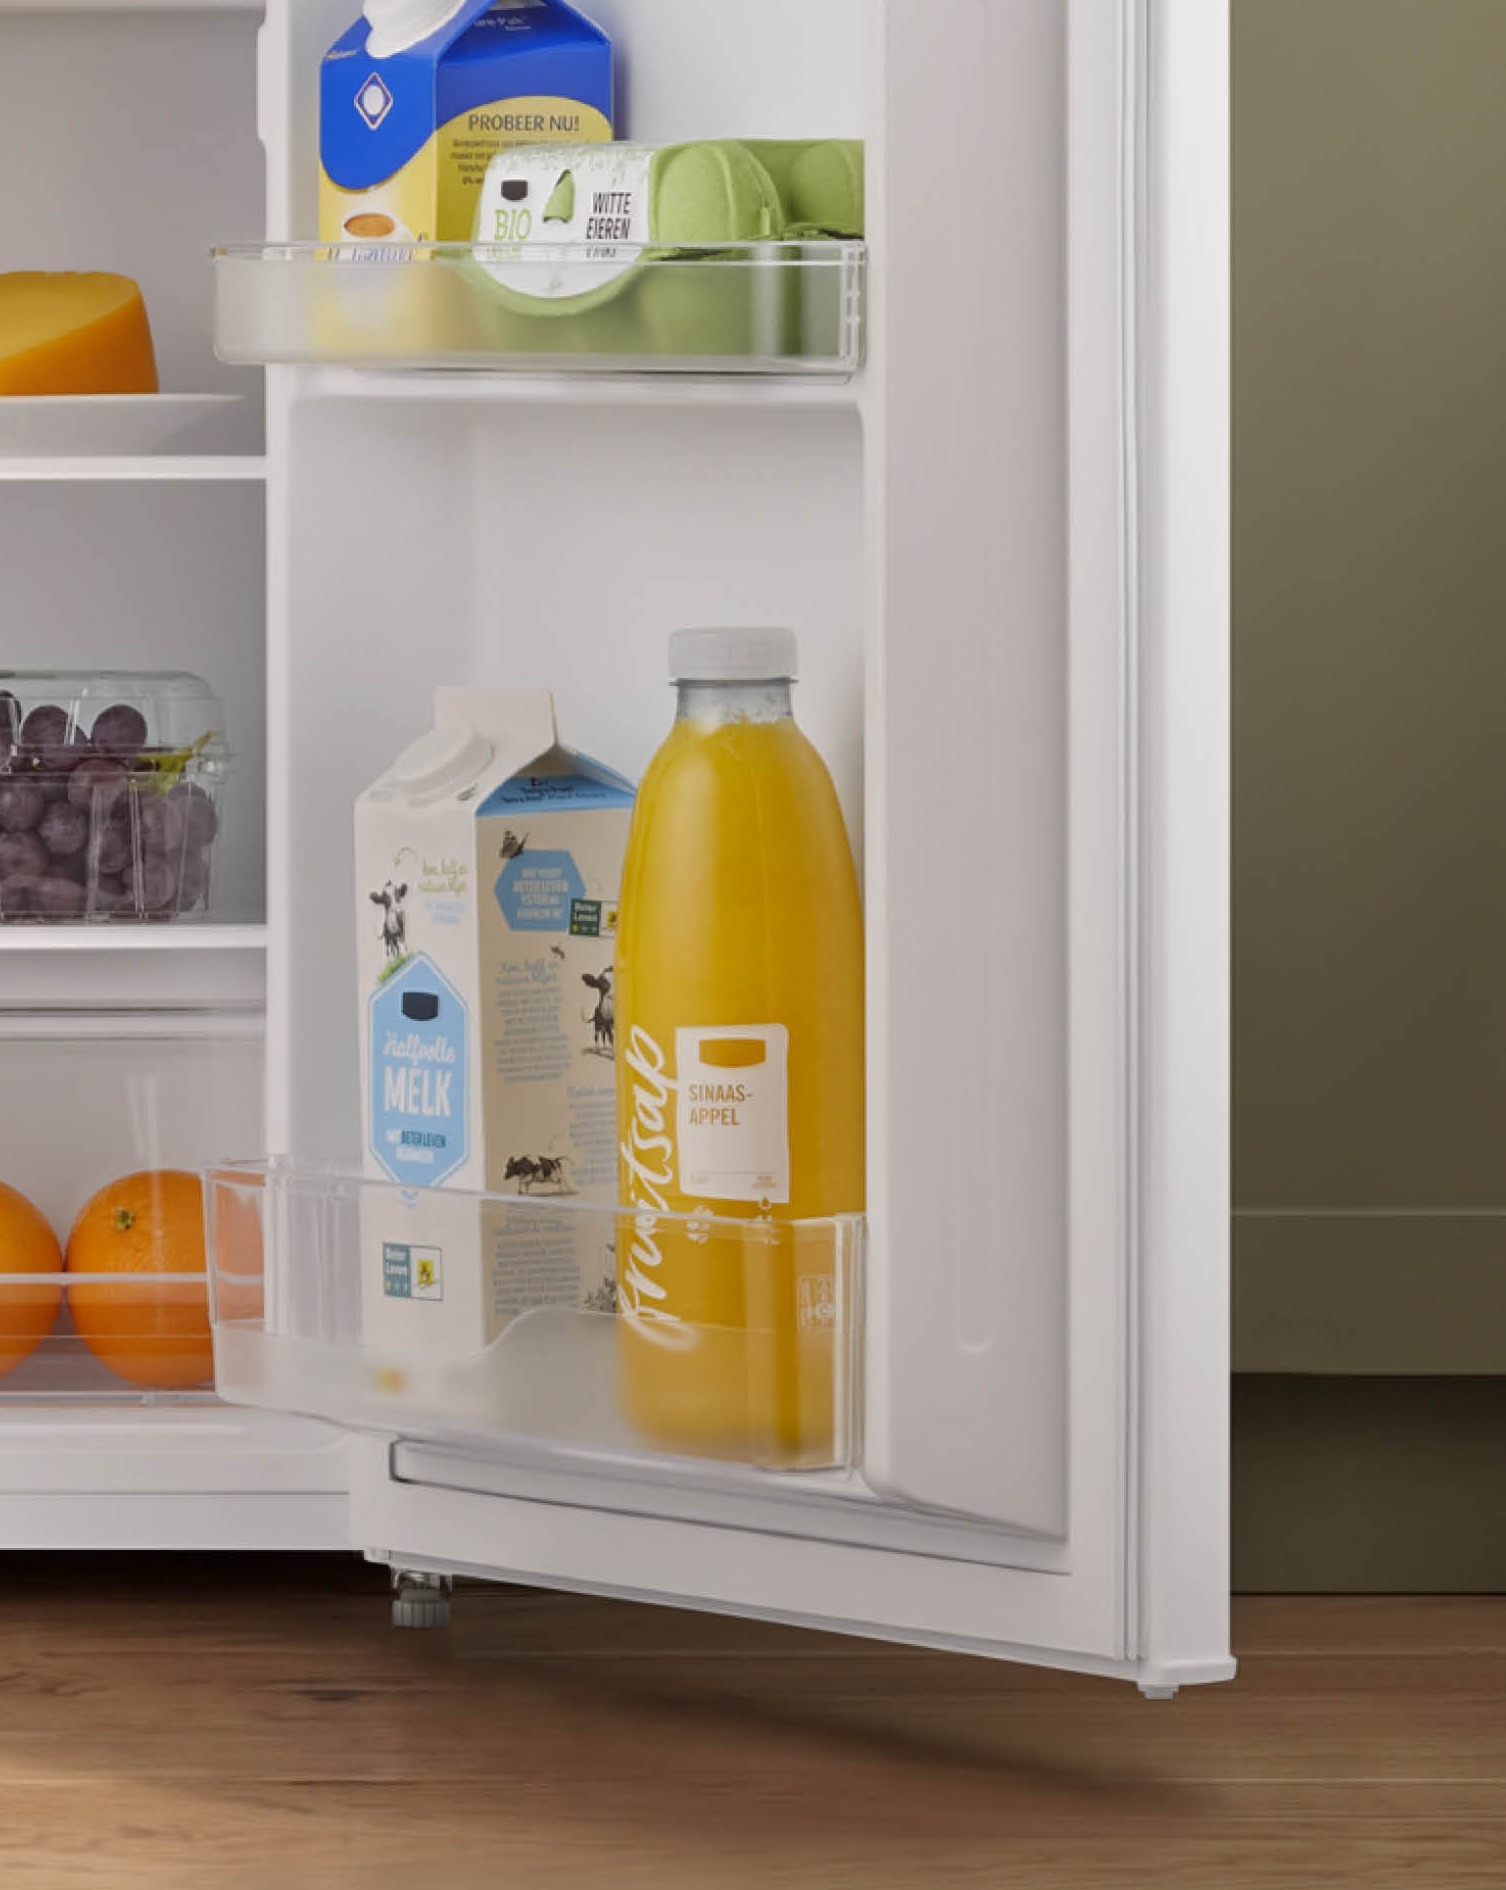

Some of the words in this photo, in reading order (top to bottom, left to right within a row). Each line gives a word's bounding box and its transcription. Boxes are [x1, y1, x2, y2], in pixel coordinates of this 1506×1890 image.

[468, 114, 546, 132] PROBEER
[549, 115, 581, 132] NU!
[592, 191, 632, 215] WITTE
[493, 208, 533, 242] BIO
[586, 217, 632, 241] EIEREN
[384, 1065, 454, 1118] MELK
[689, 1084, 755, 1103] SINAAS-
[689, 1107, 741, 1127] APPEL
